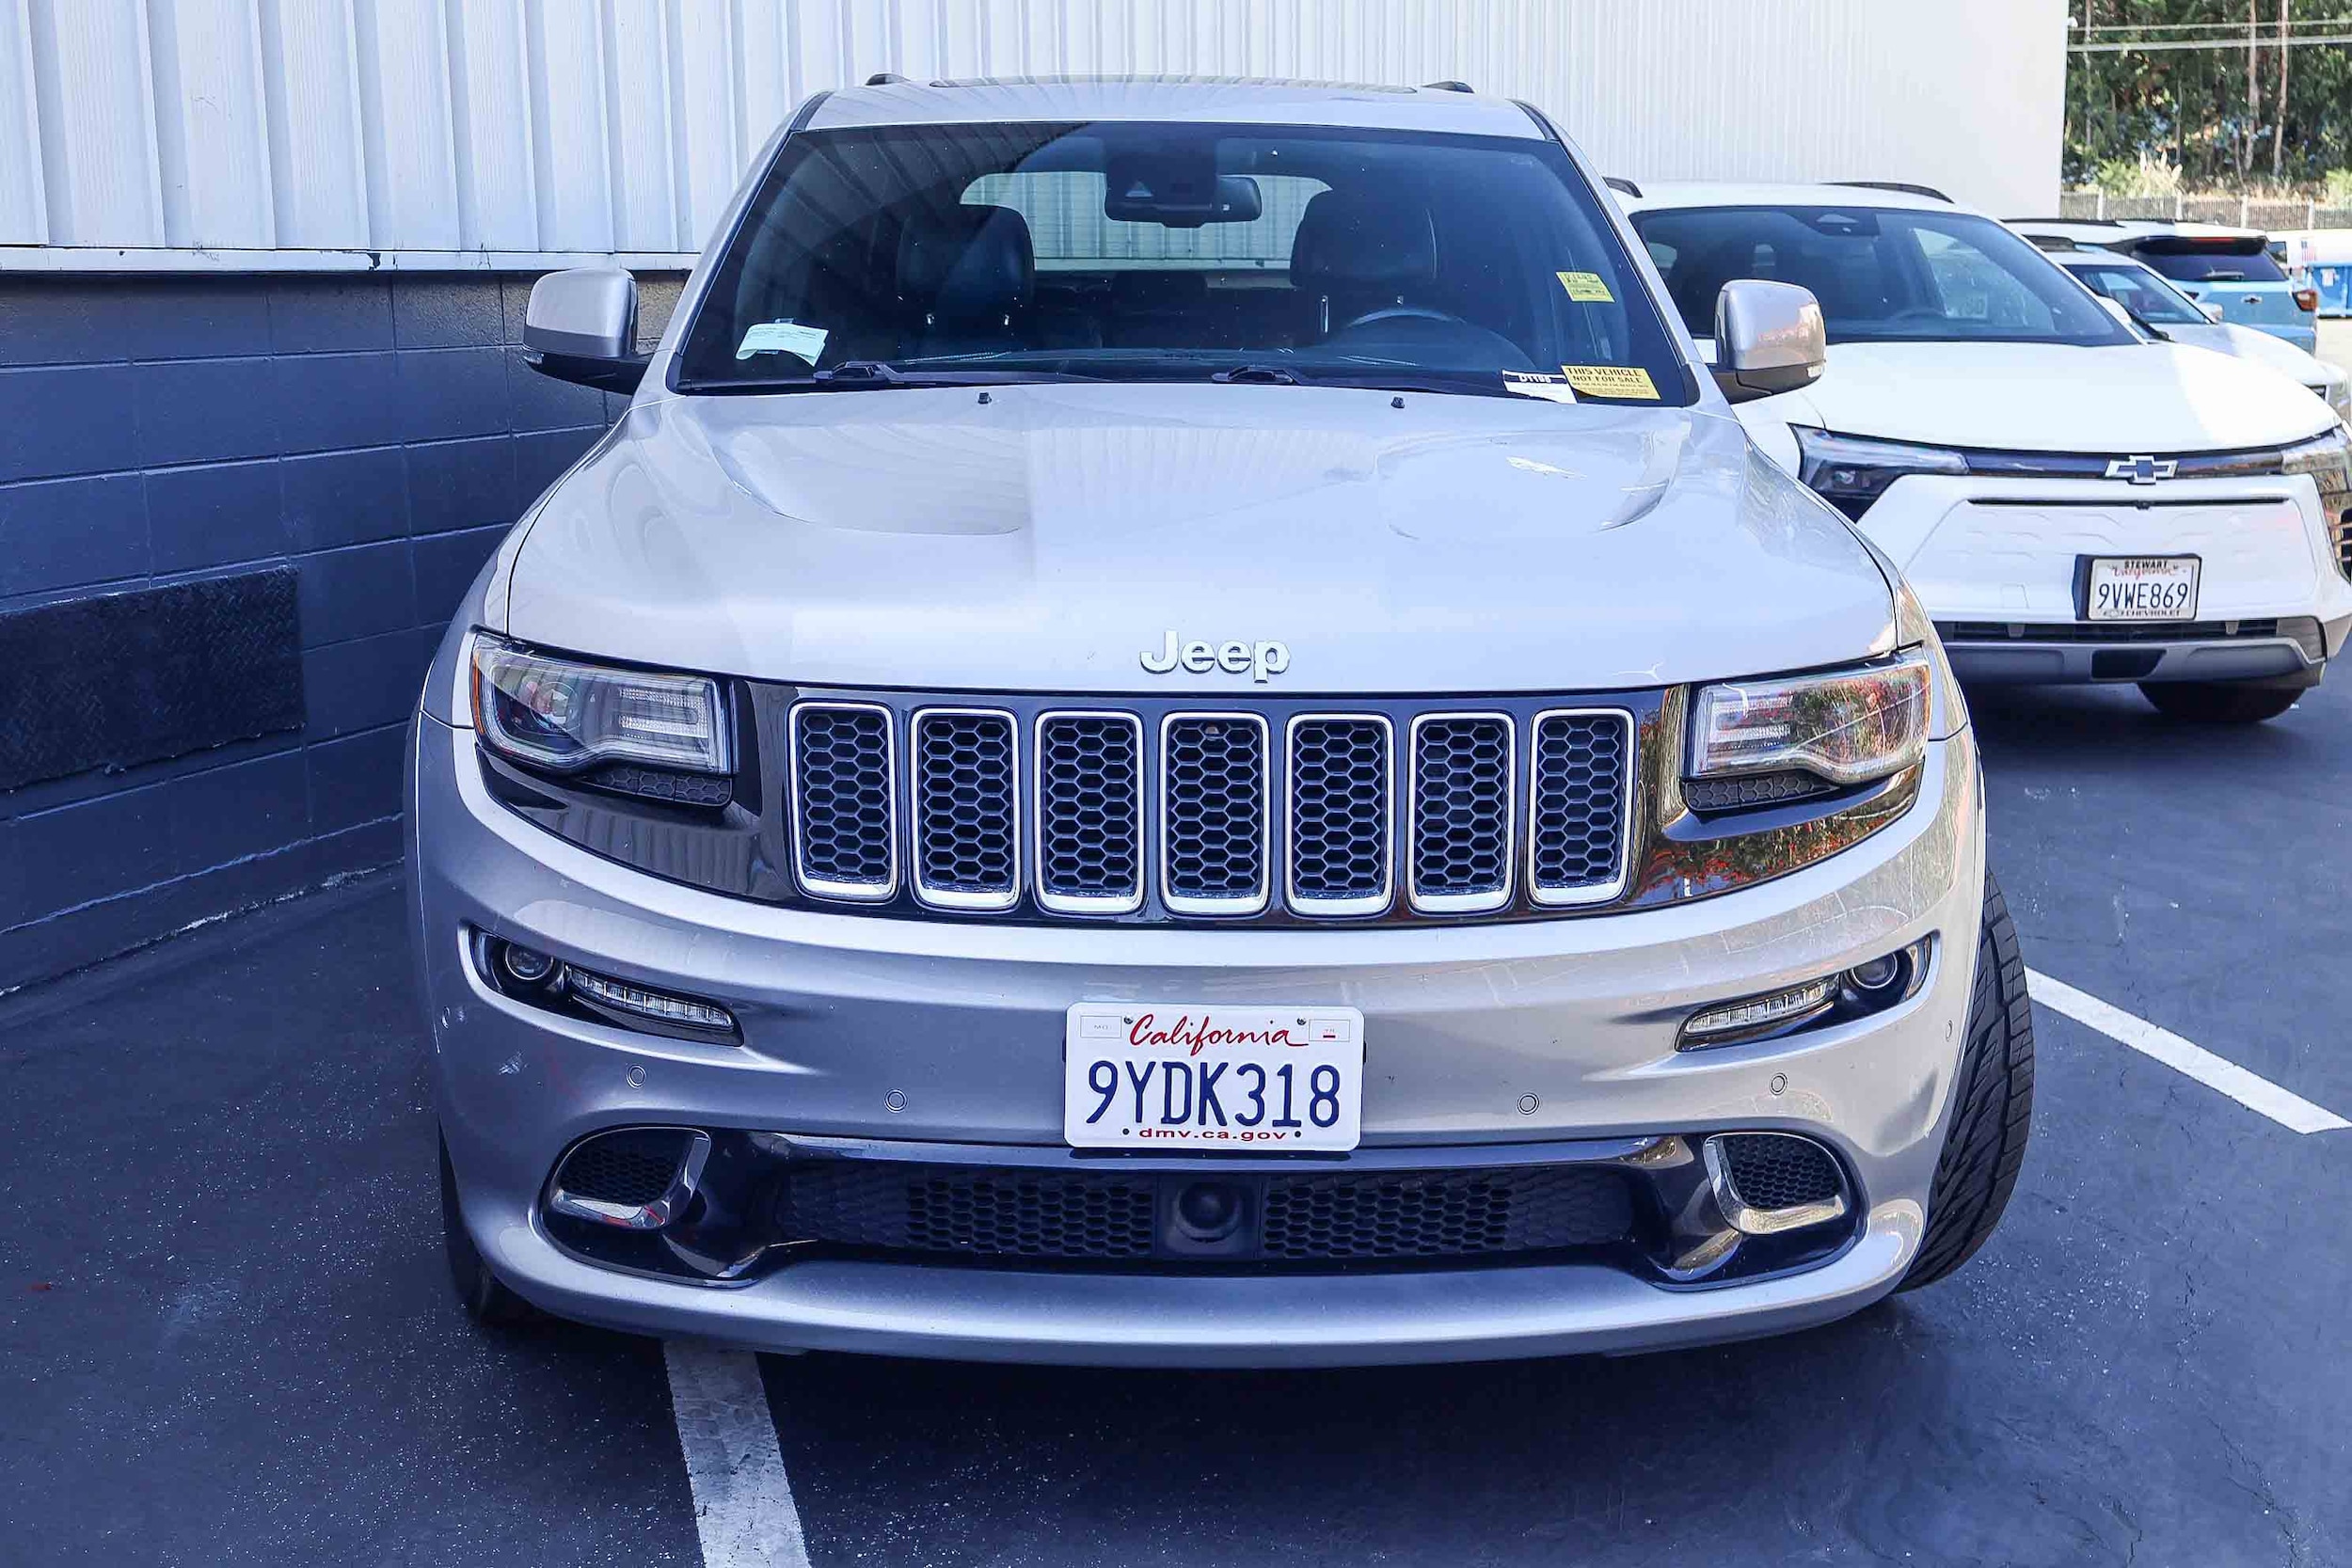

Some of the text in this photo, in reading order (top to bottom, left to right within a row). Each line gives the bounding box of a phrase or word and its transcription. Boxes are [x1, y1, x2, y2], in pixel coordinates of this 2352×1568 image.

[1565, 367, 1643, 377] THIS VEHICLE
[2123, 560, 2169, 569] STEWART
[2097, 582, 2189, 610] 9VWE869
[1139, 629, 1291, 684] Jeep
[1129, 1013, 1310, 1056] California
[1086, 1060, 1341, 1128] 9YDK318
[1138, 1127, 1288, 1142] dmv.ca.gov
